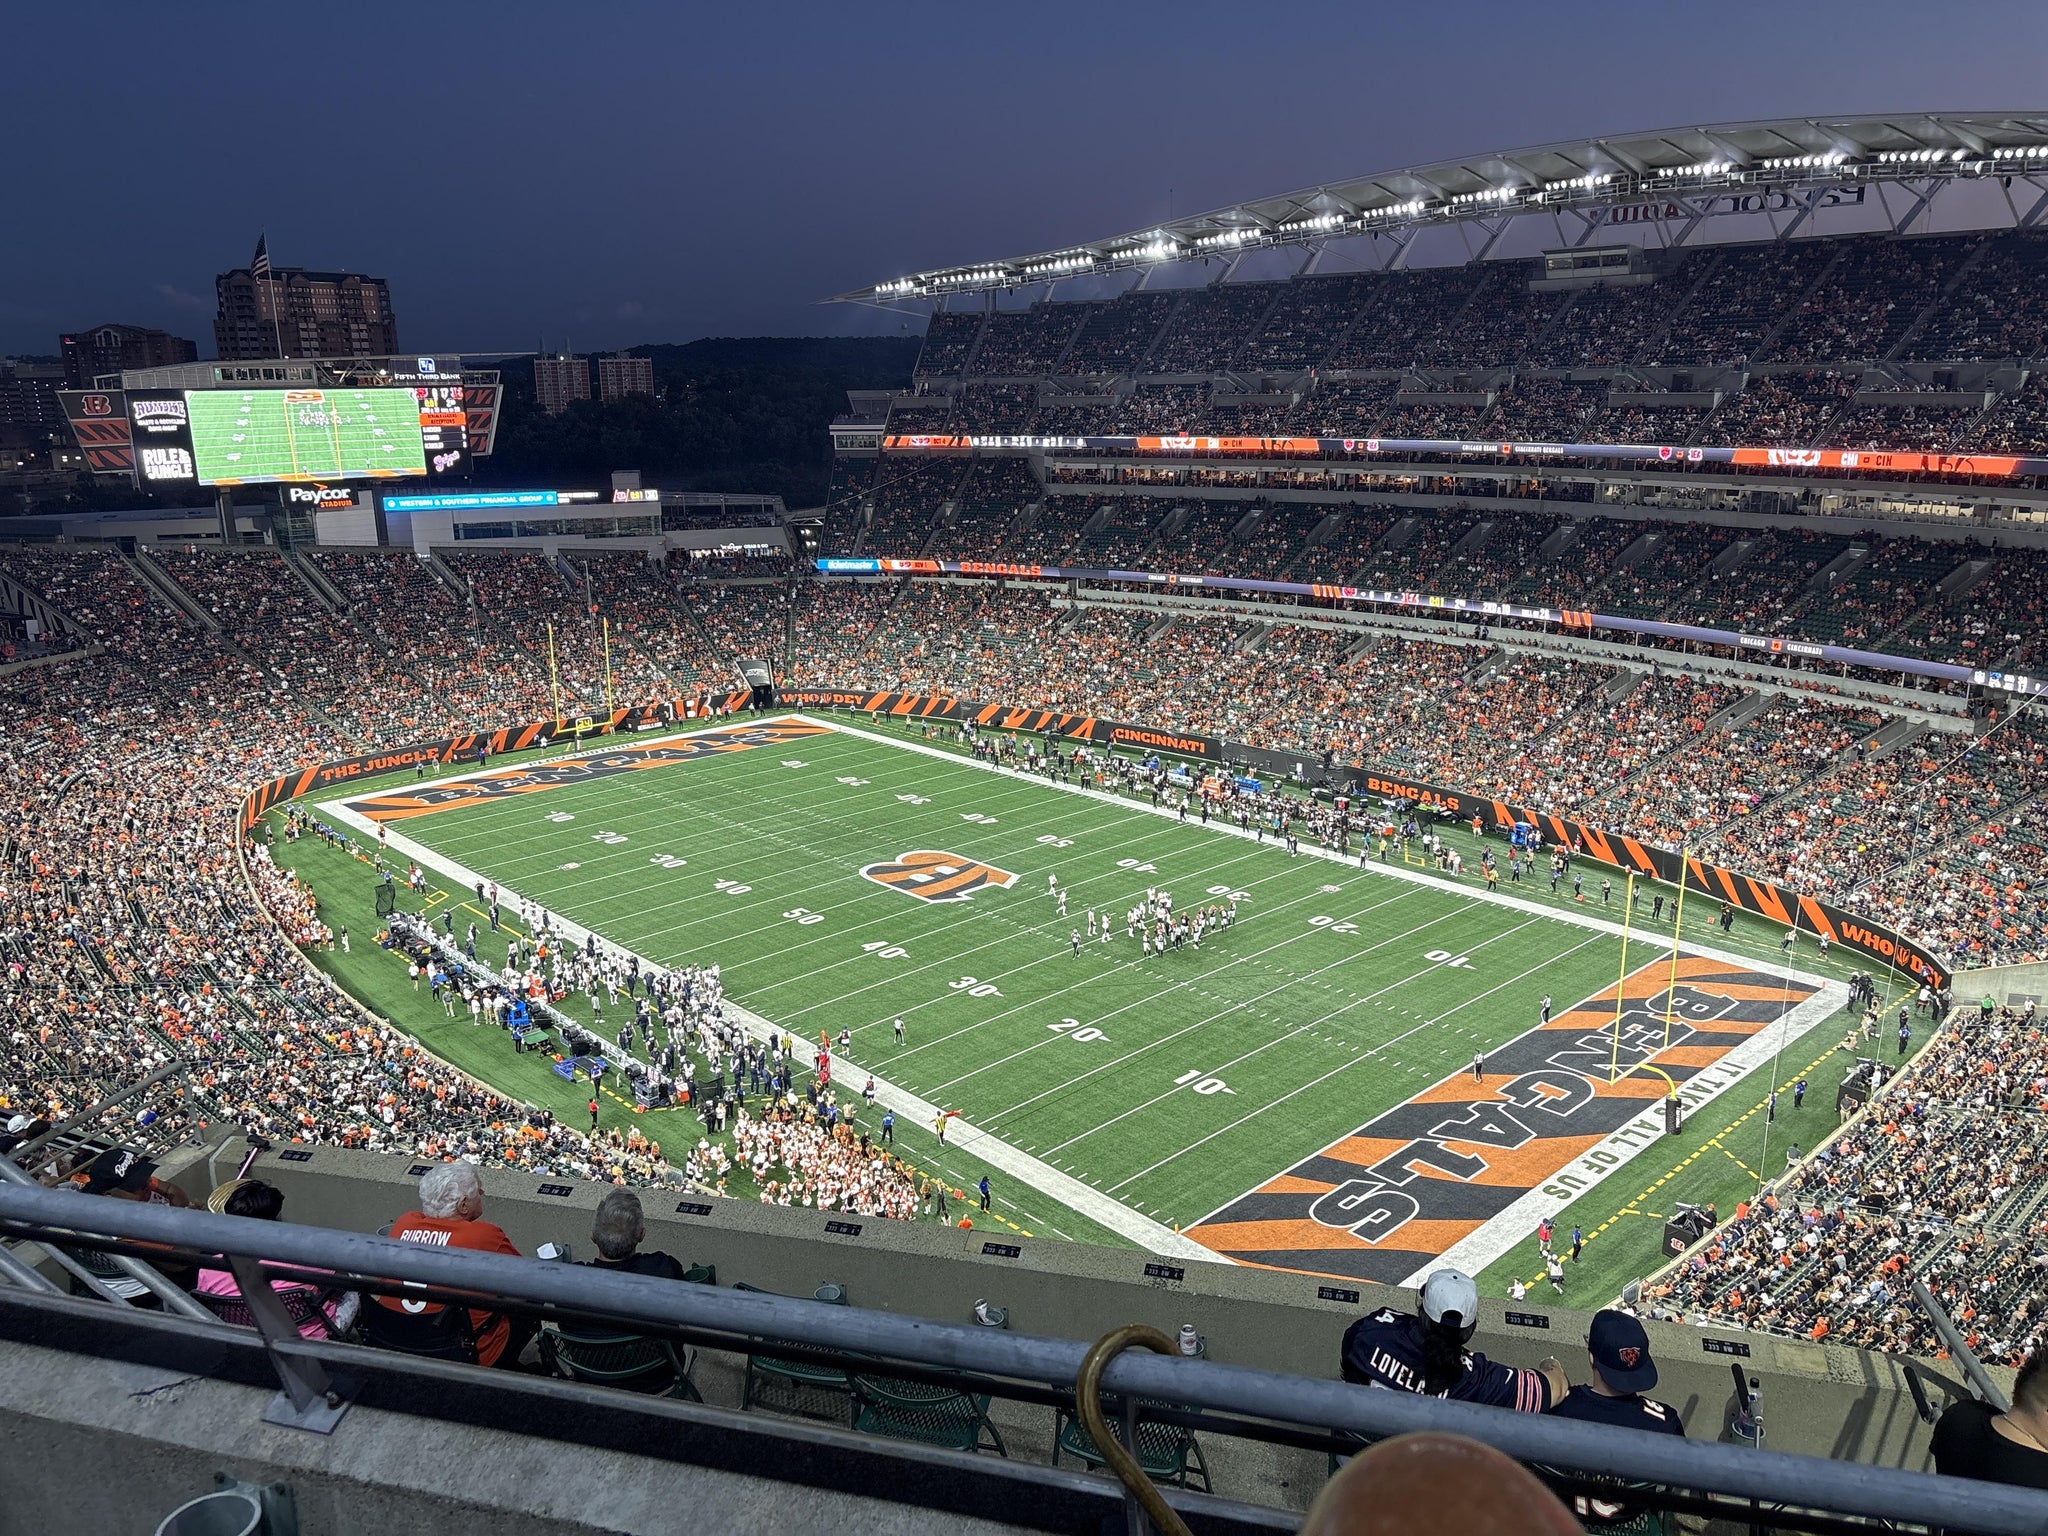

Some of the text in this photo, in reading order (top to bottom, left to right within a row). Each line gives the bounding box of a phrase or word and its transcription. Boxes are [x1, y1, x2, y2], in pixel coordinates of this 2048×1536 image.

[1841, 453, 1858, 465] CHI
[1876, 456, 1892, 467] CIN
[290, 488, 350, 504] Paycor
[442, 498, 479, 506] SOUTHERN
[959, 561, 1041, 576] BENGALS
[782, 694, 864, 704] WHO DEY
[1114, 728, 1205, 753] CINCINNATI
[321, 747, 439, 781] THE JUNGLE
[414, 729, 781, 805] BENGALS
[1368, 777, 1460, 811] BENGALS
[652, 855, 687, 868] 30
[1116, 859, 1153, 872] 40
[715, 882, 752, 895] 40
[1206, 885, 1245, 900] 30
[783, 908, 825, 925] 50
[1308, 916, 1350, 933] 20
[1840, 921, 1894, 956] WHO
[861, 941, 906, 959] 40
[1424, 950, 1462, 968] 10
[949, 976, 1000, 998] 30
[1046, 1018, 1104, 1042] 20
[1721, 1061, 1747, 1078] IT
[1174, 1069, 1227, 1095] 10
[1309, 985, 1740, 1244] BENGALS
[1610, 1119, 1661, 1147] ALL
[1581, 1151, 1620, 1175] OF
[1542, 1174, 1588, 1200] US
[400, 1229, 451, 1247] BURROW
[1369, 1346, 1450, 1400] LOVELA
